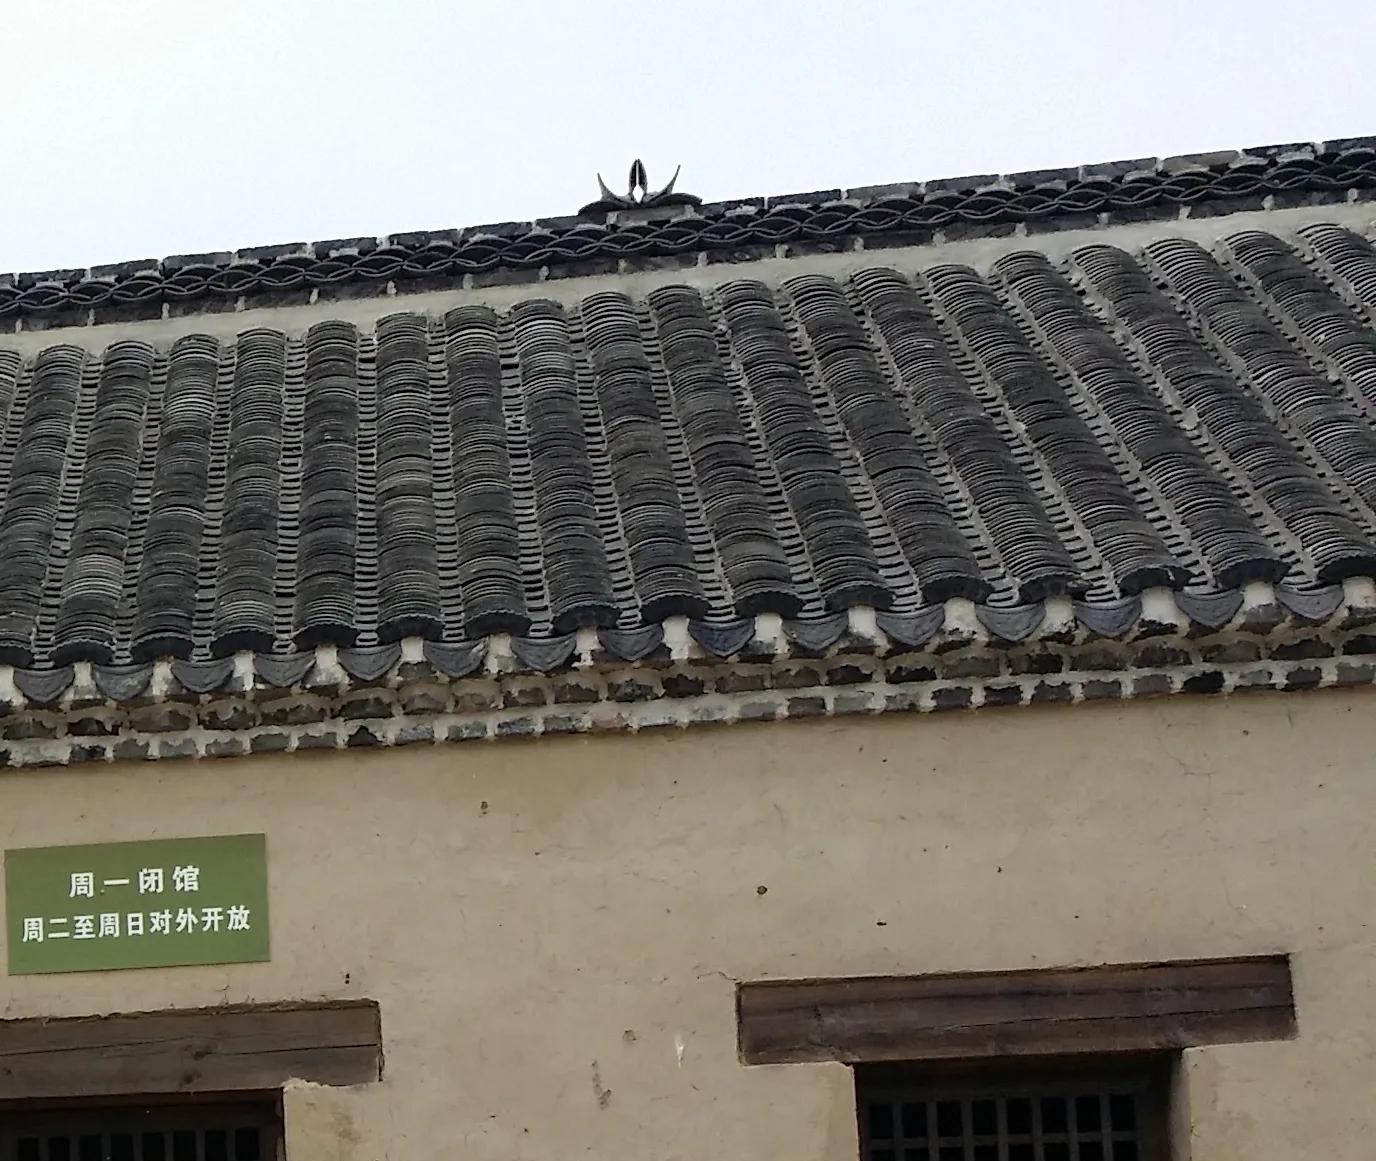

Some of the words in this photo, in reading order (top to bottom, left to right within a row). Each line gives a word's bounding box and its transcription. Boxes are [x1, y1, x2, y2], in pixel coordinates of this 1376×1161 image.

[69, 865, 199, 898] 周一闭馆
[22, 905, 250, 942] 周二至周日对外开放
